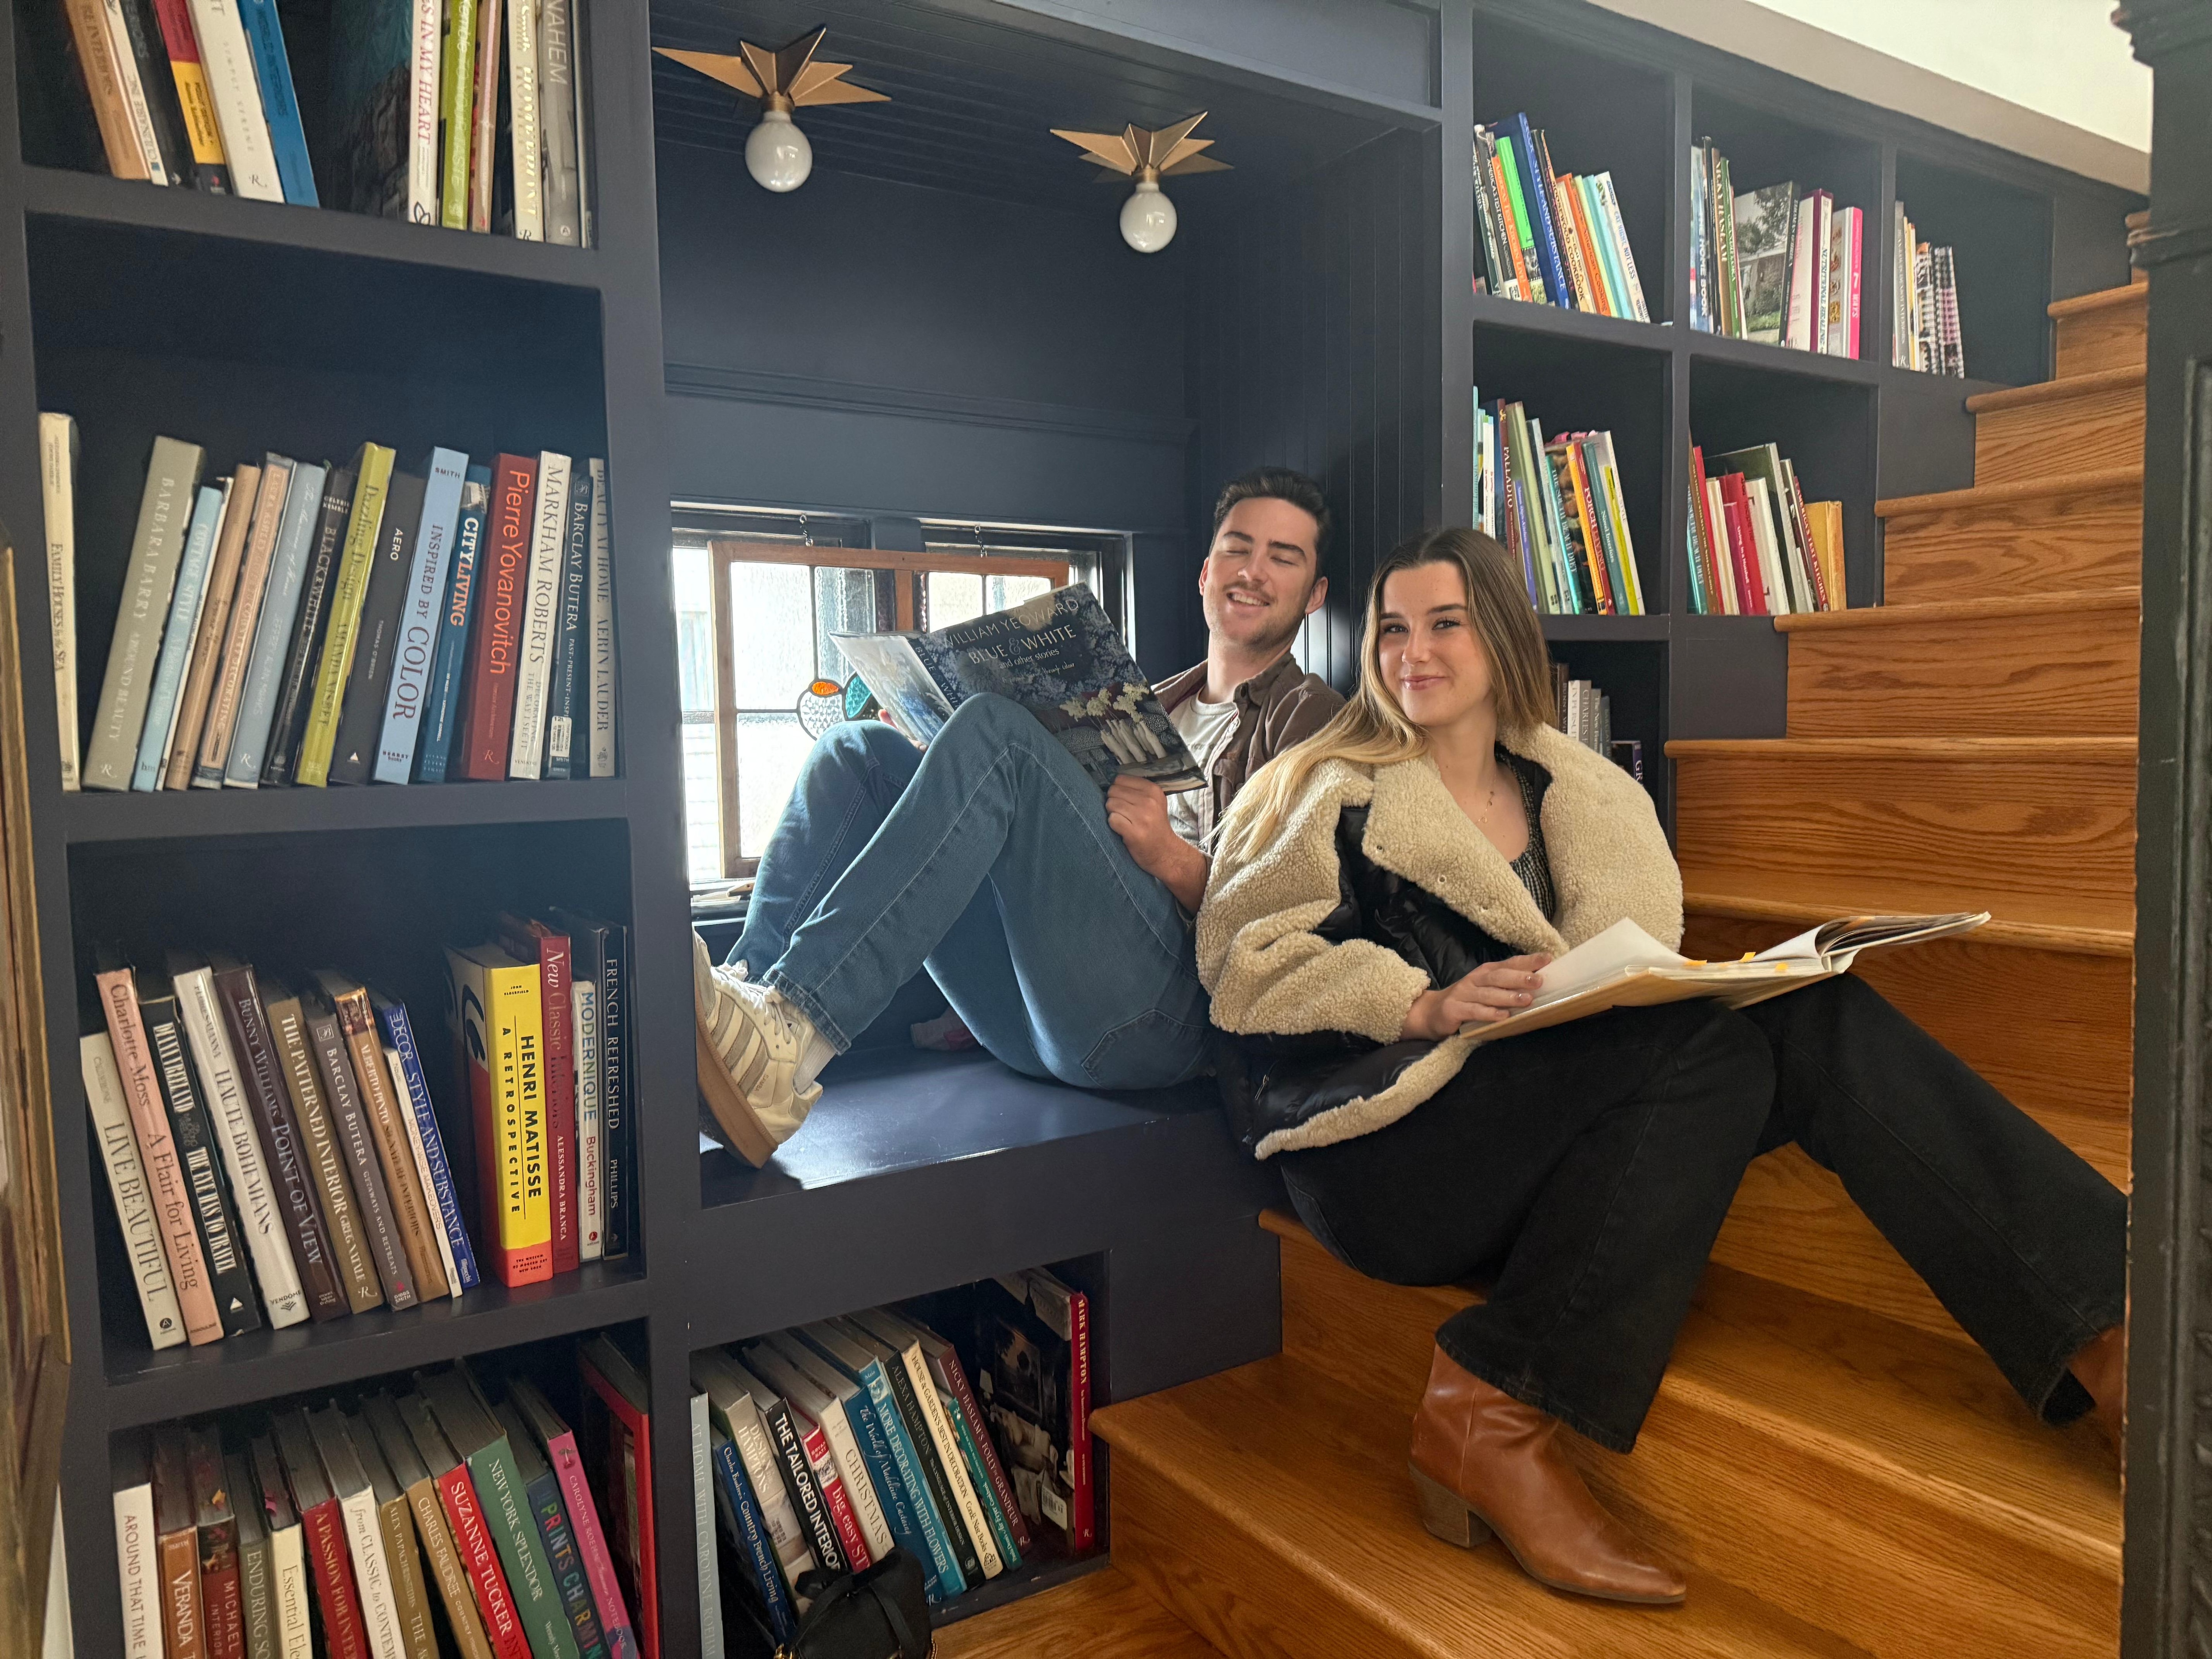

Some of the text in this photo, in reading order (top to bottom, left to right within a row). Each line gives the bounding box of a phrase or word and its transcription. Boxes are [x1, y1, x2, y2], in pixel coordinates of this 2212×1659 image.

[418, 20, 434, 144] IN MY HEART
[1495, 212, 1509, 244] KITCHEN
[1565, 246, 1586, 300] COOKBOOK
[1626, 261, 1636, 280] LESS
[1699, 278, 1708, 316] BOOK
[435, 467, 460, 479] SMITH
[1502, 445, 1512, 507] PALLADIO
[1584, 486, 1599, 528] PORCH
[131, 476, 175, 620] BARBARA BARRY
[316, 525, 337, 575] BLACK
[341, 484, 380, 603] Dazzling Design
[388, 527, 405, 562] AERO
[490, 471, 529, 673] Pierre Yovanovitch
[530, 467, 562, 662] MARKHAM ROBERTS
[566, 502, 588, 630] BARCLAY BUTERA
[1600, 509, 1616, 563] Novel Interiors
[1812, 560, 1827, 602] KITCHEN
[393, 526, 442, 718] INSPIRED BY COLOR
[595, 556, 608, 732] HOME LAUDER
[915, 646, 936, 672] BLUE
[968, 624, 1077, 664] BLUE & WHITE
[1000, 599, 1079, 632] YEOWARD
[1000, 648, 1060, 670] and other stories
[1581, 689, 1590, 735] CHARLES
[111, 981, 155, 1106] Charlotte Moss
[237, 998, 259, 1045] BUNNY
[547, 949, 566, 1049] New Classic
[282, 1014, 349, 1216] THE PATTERNED INTERIOR
[326, 1046, 366, 1165] BARCLAY BUTERA
[372, 1091, 389, 1125] PINTO
[501, 1027, 520, 1214] A RETROSPECTIVE
[519, 1035, 542, 1198] HENRI MATISSE
[580, 992, 596, 1216] MODERNIQUE Buckingham
[606, 959, 620, 1208] FRENCH REFRESHED PHILLIPS
[754, 1073, 770, 1093] SAMBA
[215, 1069, 272, 1233] HAUTE BOHEMIANS
[272, 1122, 326, 1267] POINT OF VIEW
[404, 1072, 464, 1244] STYLE AND SUBSTANCE
[405, 1117, 446, 1228] MONEY-WISE MAKEOVERS
[556, 1135, 567, 1240] ALESSANDRA BRANCA
[104, 1123, 166, 1300] LIVE BEAUTIFUL
[148, 1131, 205, 1290] A Flair for Living
[338, 1214, 366, 1283] GREG NATALE
[375, 1214, 386, 1234] AND
[395, 1294, 411, 1305] SMITH
[1077, 1298, 1087, 1329] MARK
[1078, 1331, 1088, 1383] HAMPTON
[892, 1366, 934, 1454] ALEXA HAMPTON
[910, 1355, 926, 1382] HOUSE
[944, 1442, 951, 1453] IN
[949, 1360, 1018, 1526] NICKY HASLAM'S FOLLY GRANDEUR
[570, 1475, 590, 1523] CAROLYNE
[775, 1413, 819, 1513] THE TAILORED
[846, 1449, 886, 1543] CHRISTMAS
[866, 1423, 901, 1499] World Madeleine
[875, 1402, 949, 1575] MORE DECORATING WITH FLOWERS
[350, 1509, 381, 1589] from CLASSIC
[416, 1498, 463, 1598] CHARLES FAUDREE
[489, 1459, 545, 1602] NEW YORK SPLENDOR
[541, 1505, 573, 1566] PRINTS
[691, 1423, 711, 1603] AT CAROLYNE
[738, 1501, 780, 1601] Country French Living
[840, 1515, 857, 1543] easy
[972, 1519, 988, 1551] Nast Books
[122, 1514, 147, 1650] AROUND THAT TIME
[247, 1550, 268, 1637] ENDURING
[283, 1565, 303, 1630] Essential
[317, 1523, 350, 1618] PASSION FOR
[451, 1482, 511, 1636] SUZANNE TUCKER
[172, 1569, 195, 1647] VERANDA
[222, 1581, 243, 1651] MICHAEL
